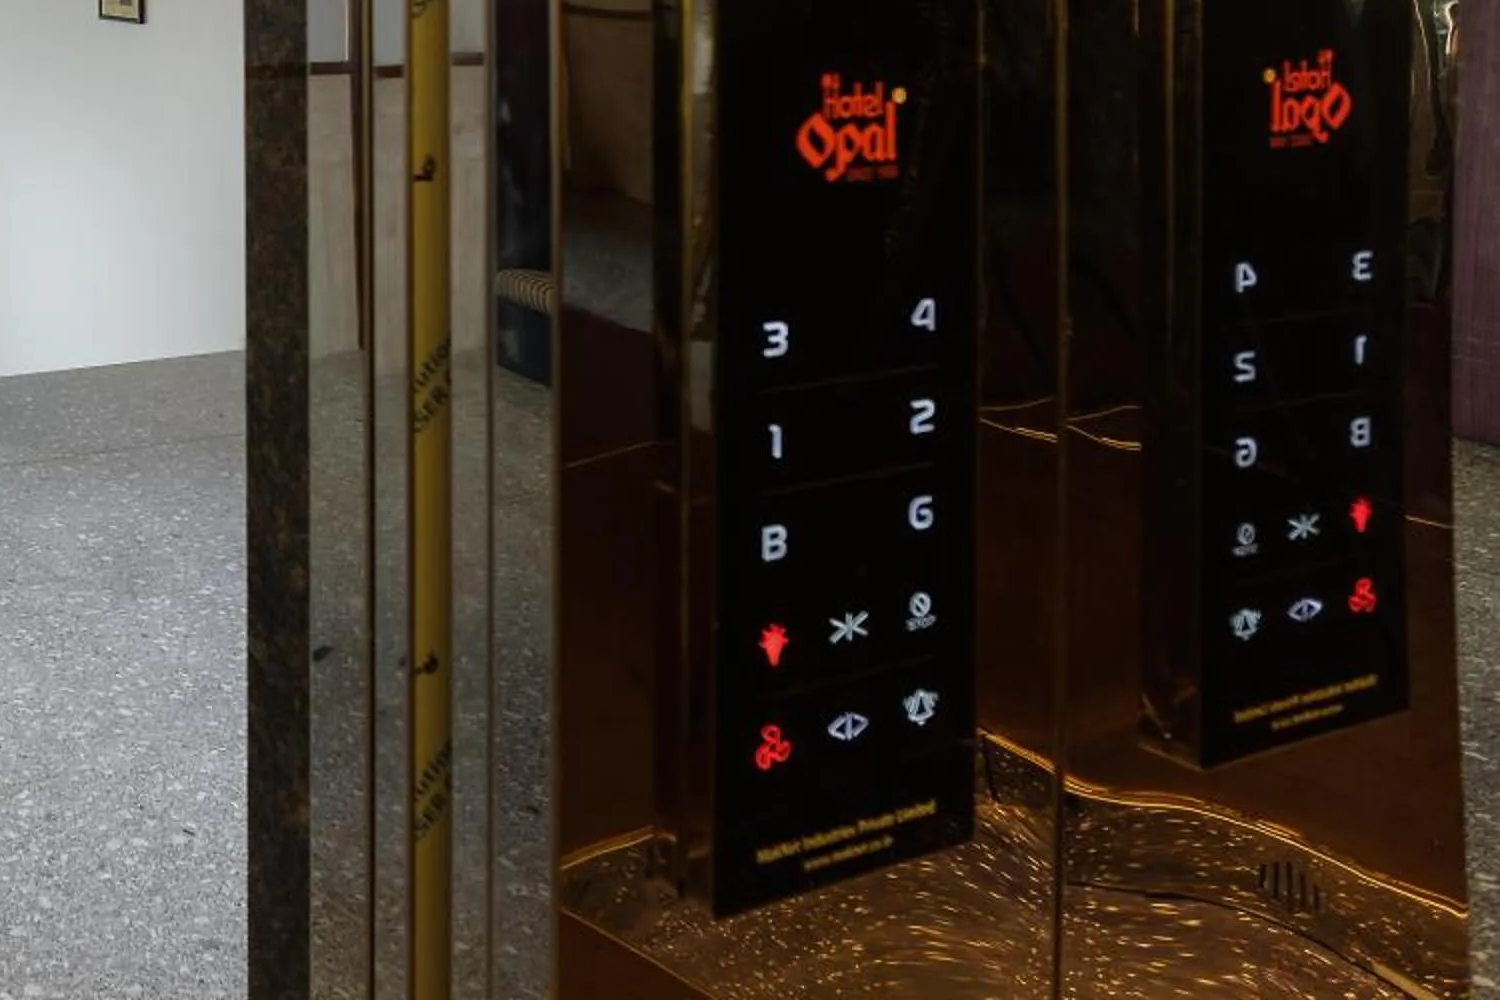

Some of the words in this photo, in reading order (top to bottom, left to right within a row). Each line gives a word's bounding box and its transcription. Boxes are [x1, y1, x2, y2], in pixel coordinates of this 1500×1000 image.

[822, 73, 883, 118] Hotel
[797, 102, 897, 182] Opal
[910, 297, 936, 331] 4
[762, 320, 789, 358] 3
[908, 398, 936, 434] 2
[768, 423, 783, 459] 1
[761, 523, 788, 562] B
